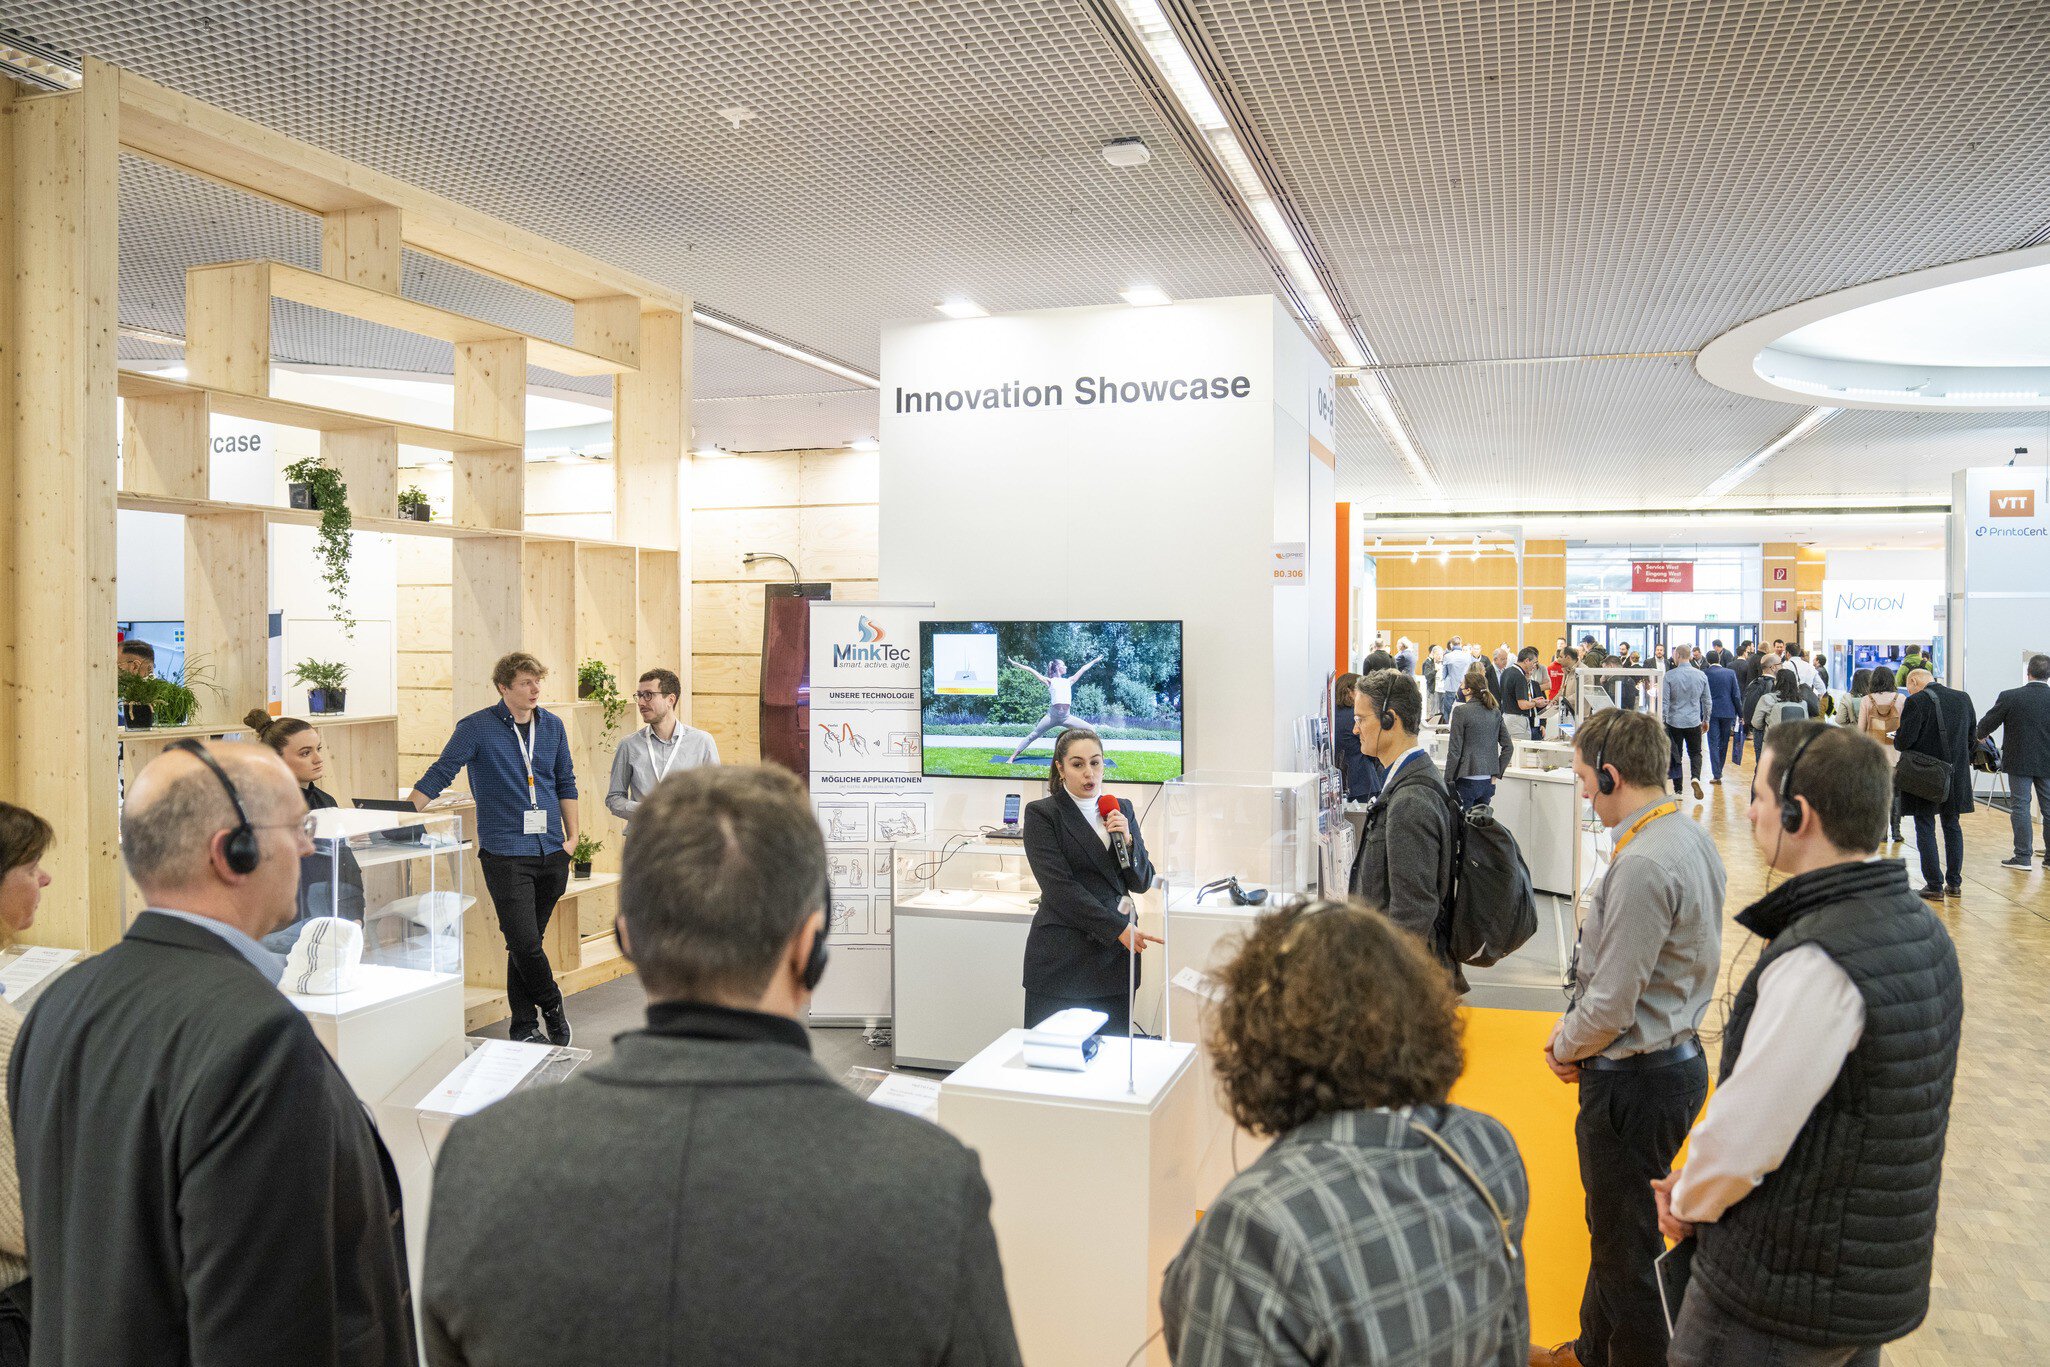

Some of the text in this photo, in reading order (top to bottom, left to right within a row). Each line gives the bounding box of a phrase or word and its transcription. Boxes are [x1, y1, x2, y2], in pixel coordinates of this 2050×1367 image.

[896, 375, 1251, 414] Innovation Showcase
[1997, 496, 2028, 509] VTT
[1989, 527, 2049, 537] PrintoCent
[833, 643, 911, 667] MinkTec
[839, 660, 911, 670] smart. active. agile.
[821, 774, 861, 783] MÖGLICHE
